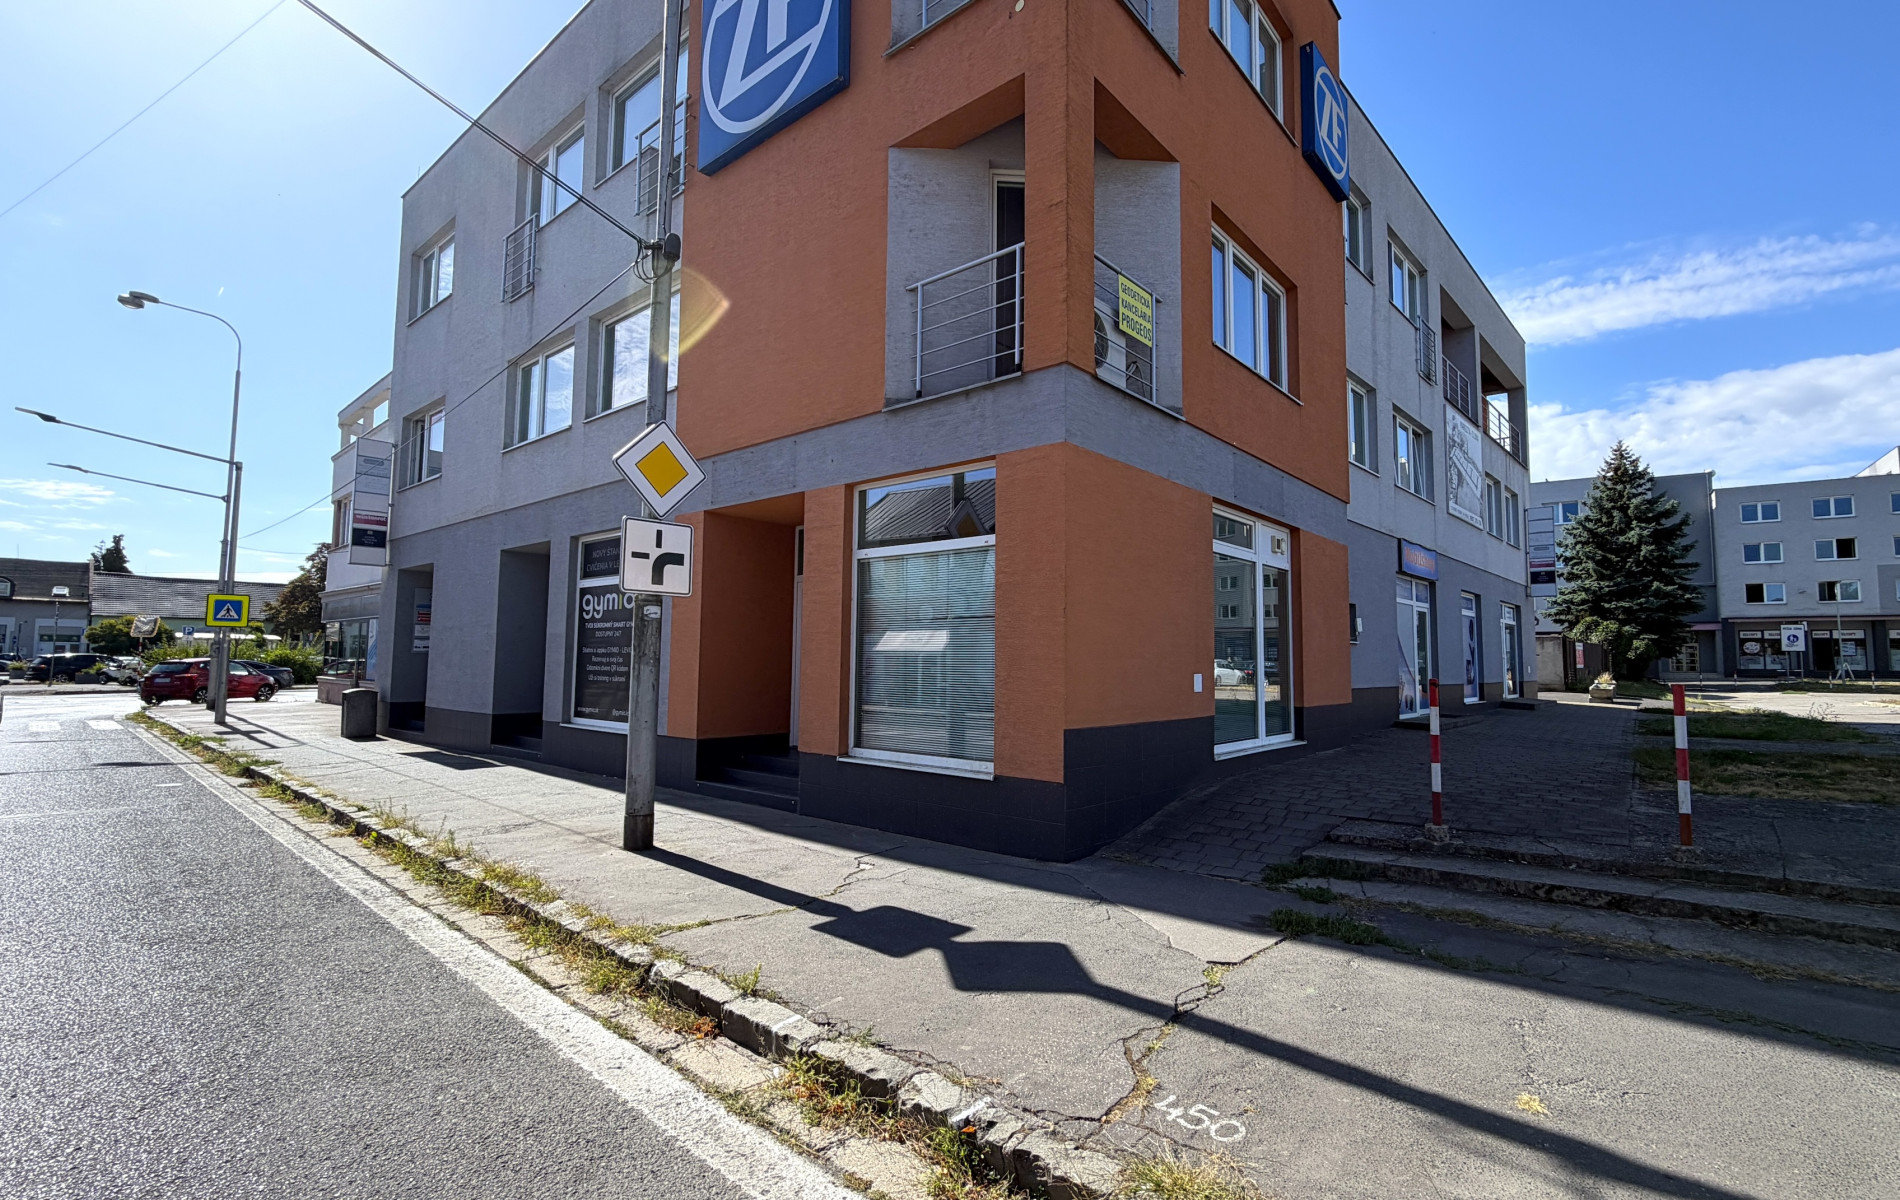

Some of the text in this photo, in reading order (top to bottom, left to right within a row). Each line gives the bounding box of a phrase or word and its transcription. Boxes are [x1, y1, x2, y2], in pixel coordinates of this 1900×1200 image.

[1316, 72, 1347, 173] ZF
[1121, 282, 1150, 310] GEODETICKÁ
[1121, 297, 1151, 325] KANCELÁRIA
[1121, 312, 1152, 342] PROGEOS
[582, 593, 635, 619] gymio
[1154, 1095, 1246, 1141] 450
